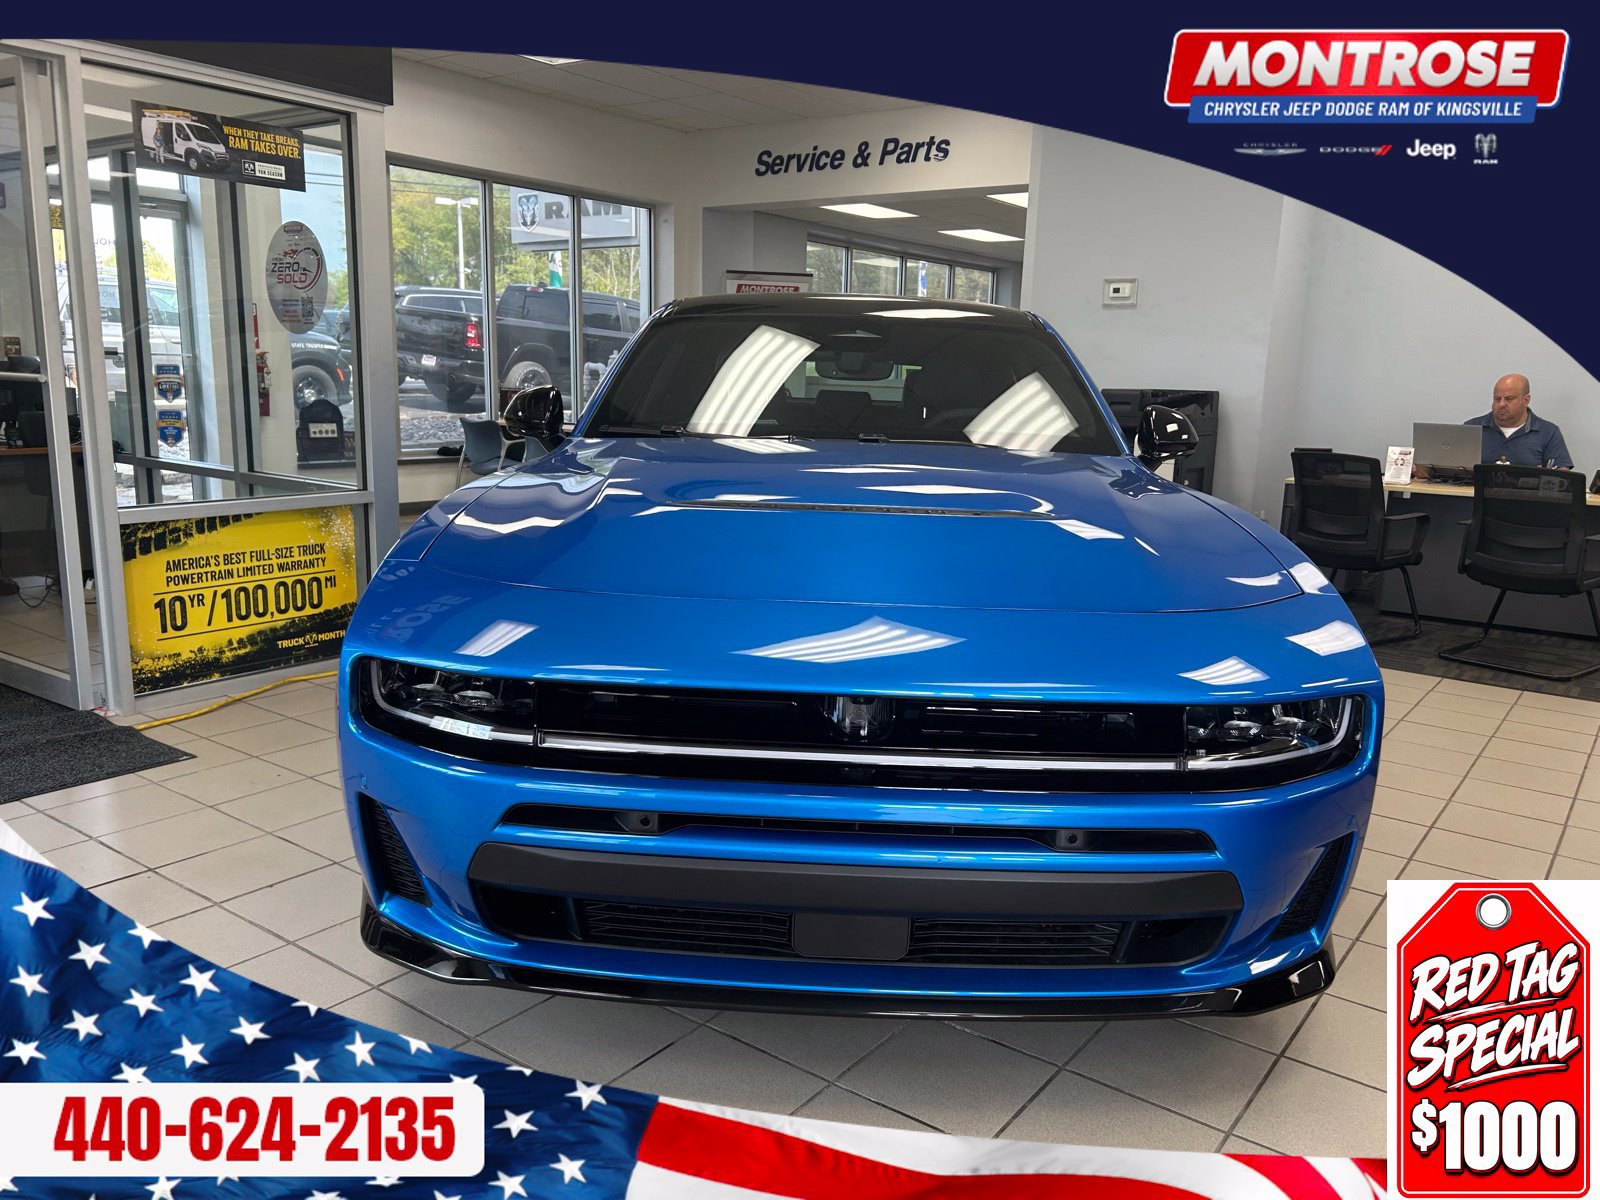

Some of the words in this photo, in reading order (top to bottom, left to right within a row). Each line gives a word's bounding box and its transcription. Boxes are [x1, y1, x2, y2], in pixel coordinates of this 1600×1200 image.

[223, 126, 241, 138] WHEN
[242, 129, 259, 140] THEY
[260, 132, 275, 143] TAKE
[276, 135, 301, 147] BREAKS,
[229, 137, 249, 150] RAM
[250, 140, 278, 154] TAKES
[278, 146, 301, 159] OVER.
[755, 146, 845, 177] Service
[852, 140, 870, 168] &
[879, 135, 950, 166] Parts
[271, 262, 300, 273] ZERO
[276, 273, 308, 284] SOLD
[740, 285, 795, 294] MONTROSE
[165, 555, 220, 573] AMERICA'S
[223, 552, 247, 566] BEST
[249, 546, 295, 563] FULL-SIZE
[296, 543, 326, 557] TRUCK
[165, 567, 234, 587] POWERTRAIN
[236, 562, 274, 579] LIMITED
[276, 557, 326, 573] WARRANTY
[277, 637, 305, 649] TRUCK
[318, 629, 346, 642] MONTH
